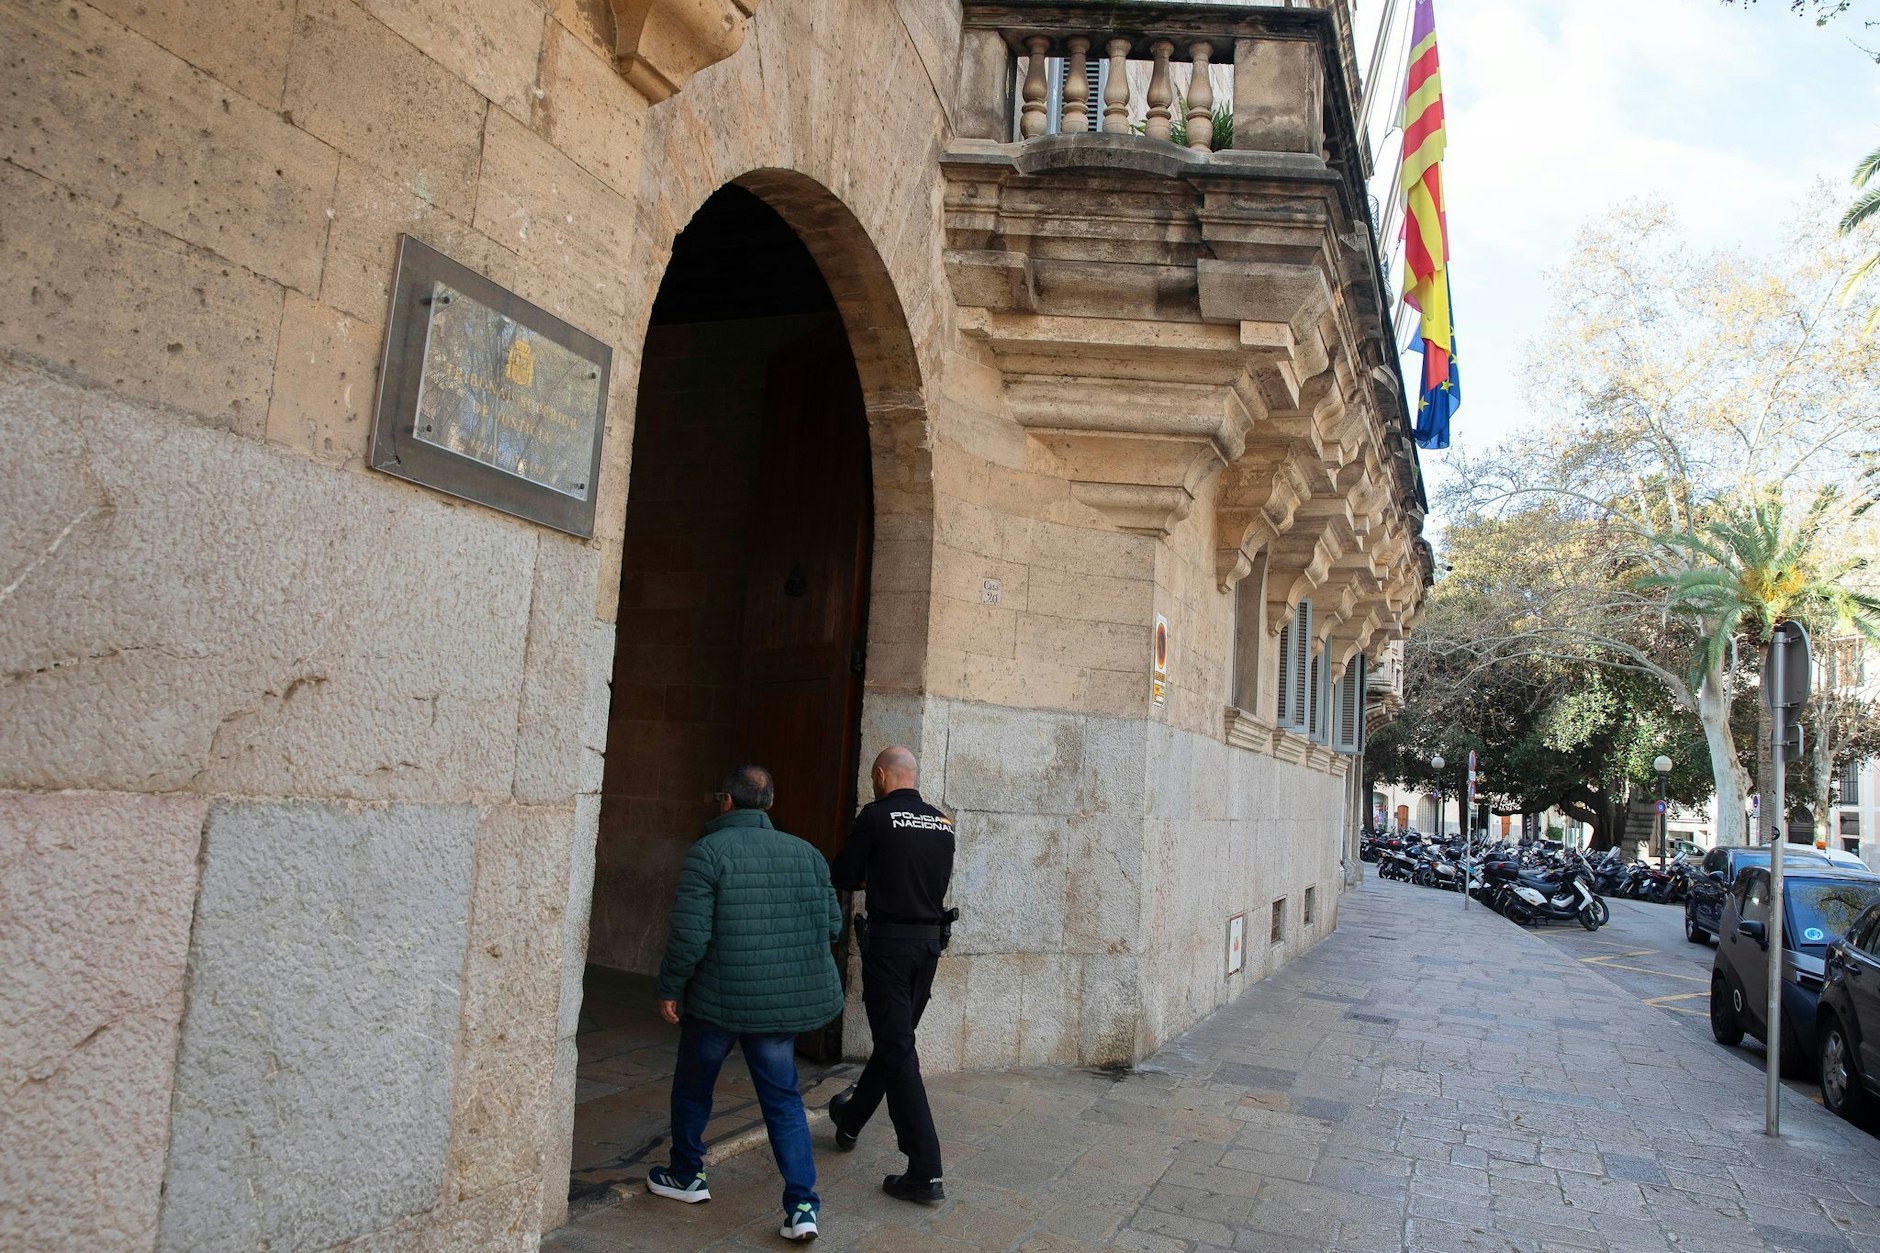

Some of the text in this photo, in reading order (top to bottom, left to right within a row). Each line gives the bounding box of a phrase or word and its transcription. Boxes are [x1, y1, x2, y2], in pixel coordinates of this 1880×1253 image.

[446, 361, 514, 403] TRIBUNAL
[472, 400, 489, 418] DE
[890, 812, 942, 823] POLICIA
[893, 820, 955, 834] NACIONAL
